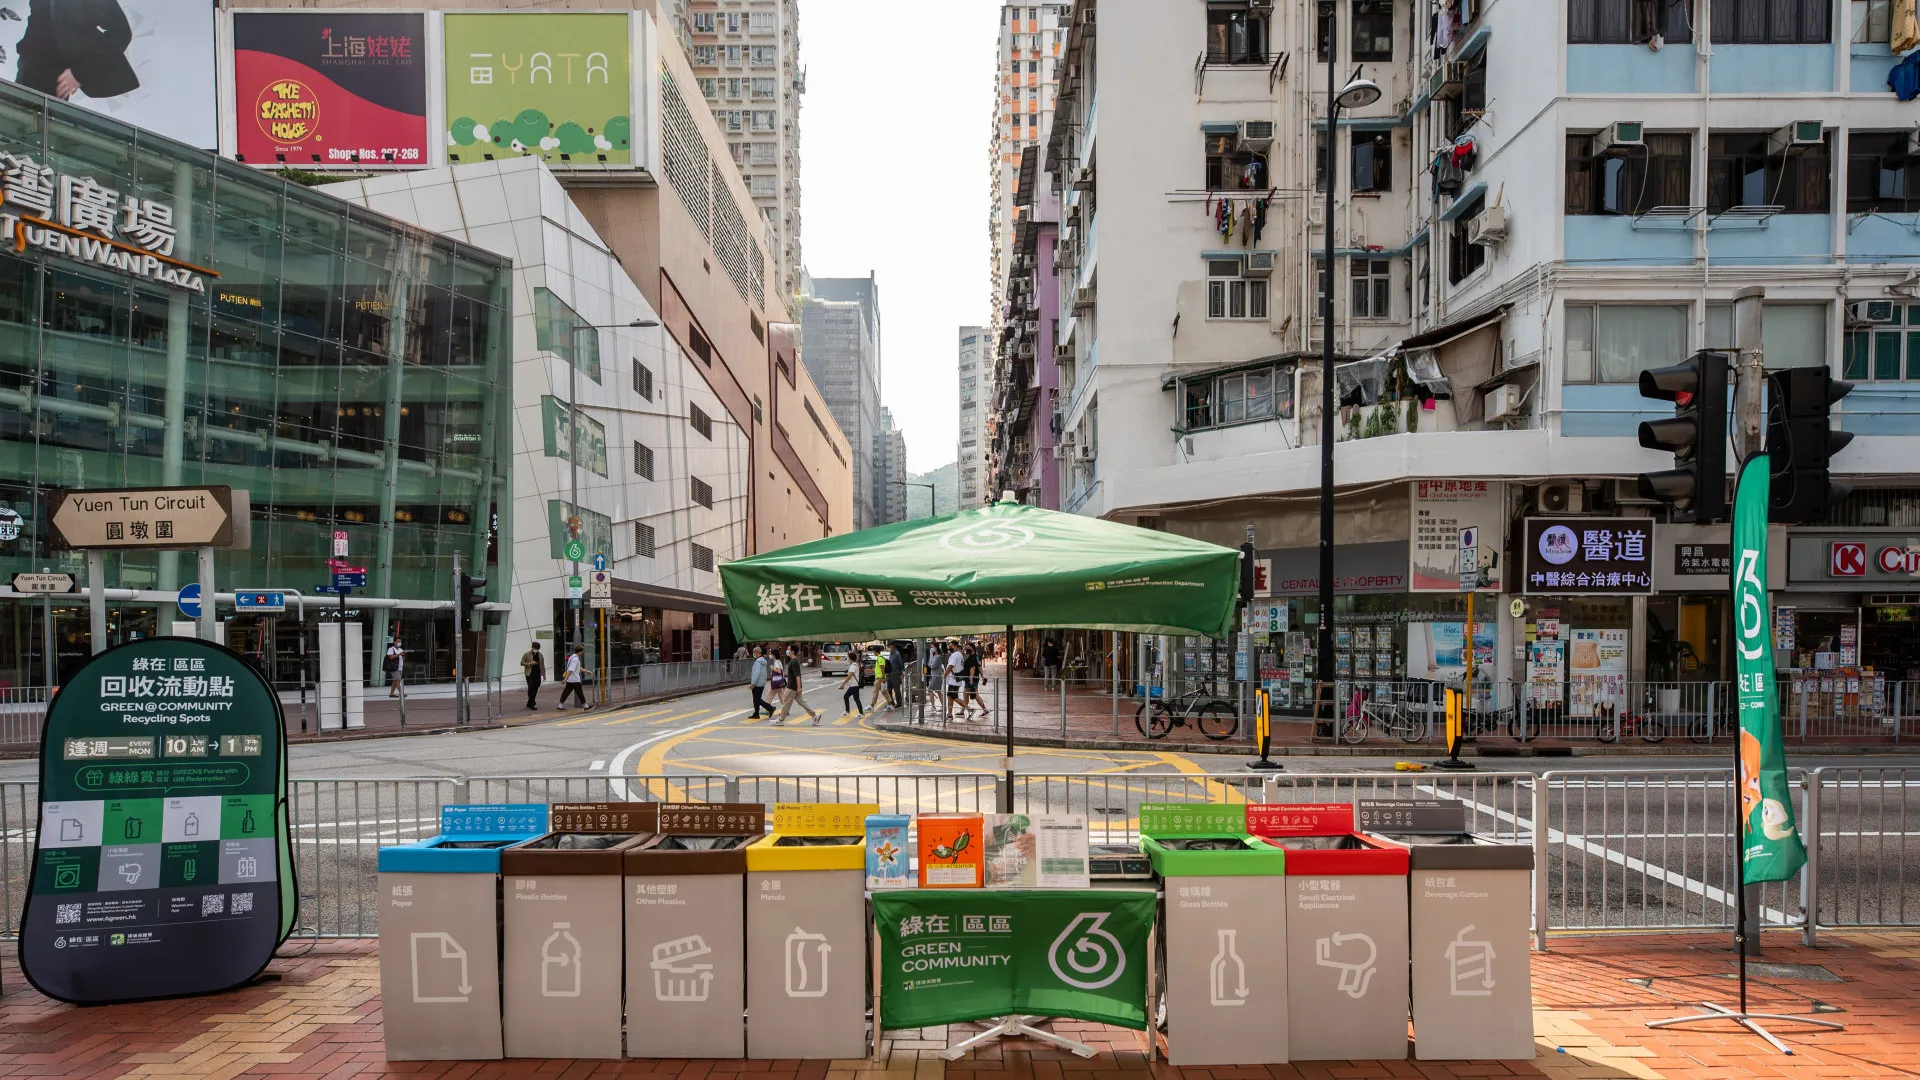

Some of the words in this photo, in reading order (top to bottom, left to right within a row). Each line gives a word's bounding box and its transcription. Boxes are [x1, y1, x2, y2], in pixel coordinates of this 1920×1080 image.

[321, 28, 412, 57] 上海姥姥
[502, 52, 608, 84] YATA
[272, 83, 300, 99] THE
[271, 122, 308, 139] HOUSE
[328, 148, 356, 160] Shops
[359, 148, 379, 159] Nos.
[220, 294, 248, 304] PUTIEN
[73, 497, 113, 512] Yuen
[119, 496, 149, 511] Tun
[154, 495, 206, 510] Circuit
[0, 527, 20, 535] EEF
[106, 520, 174, 540] 圓墩圍
[1582, 529, 1646, 562] 醫道
[1174, 580, 1205, 588] Department
[1281, 577, 1339, 590] CENTALE
[1343, 575, 1403, 588] PROPERTY
[1531, 572, 1650, 586] 中醫綜合治療中心
[757, 583, 824, 615] 綠在
[835, 586, 902, 609] 區區
[909, 589, 967, 598] GREEN
[913, 596, 1016, 606] COMMUNITY
[1270, 607, 1278, 619] 9
[1270, 620, 1278, 631] 8
[132, 657, 166, 671] 綠在
[174, 657, 206, 671] 區區
[100, 675, 235, 698] 回收流動點
[100, 702, 233, 712] GREEN@COMMUNITY
[123, 714, 177, 725] Recycling
[179, 713, 211, 723] Spots
[68, 740, 128, 757] 逢週一
[166, 739, 187, 754] 10
[228, 739, 235, 753] 1
[244, 745, 258, 753] PM
[108, 770, 154, 784] 綠綠賞
[760, 880, 781, 891] 金屬
[1298, 879, 1341, 891] 小型電器
[1424, 877, 1456, 887] 紙包盒
[392, 885, 413, 897] 紙張
[636, 884, 677, 895] 其他塑膠
[1424, 891, 1458, 899] Beverage
[541, 893, 567, 901] Bottles
[657, 897, 686, 905] Plastics
[760, 893, 785, 901] Metals
[392, 900, 413, 908] Paper
[1179, 900, 1200, 908] Glass
[1201, 900, 1228, 908] Bottles
[1298, 902, 1339, 910] Appliances
[900, 914, 949, 937] 綠在
[963, 915, 1012, 932] 區區
[901, 942, 962, 957] GREEN
[901, 955, 1012, 973] COMMUNITY
